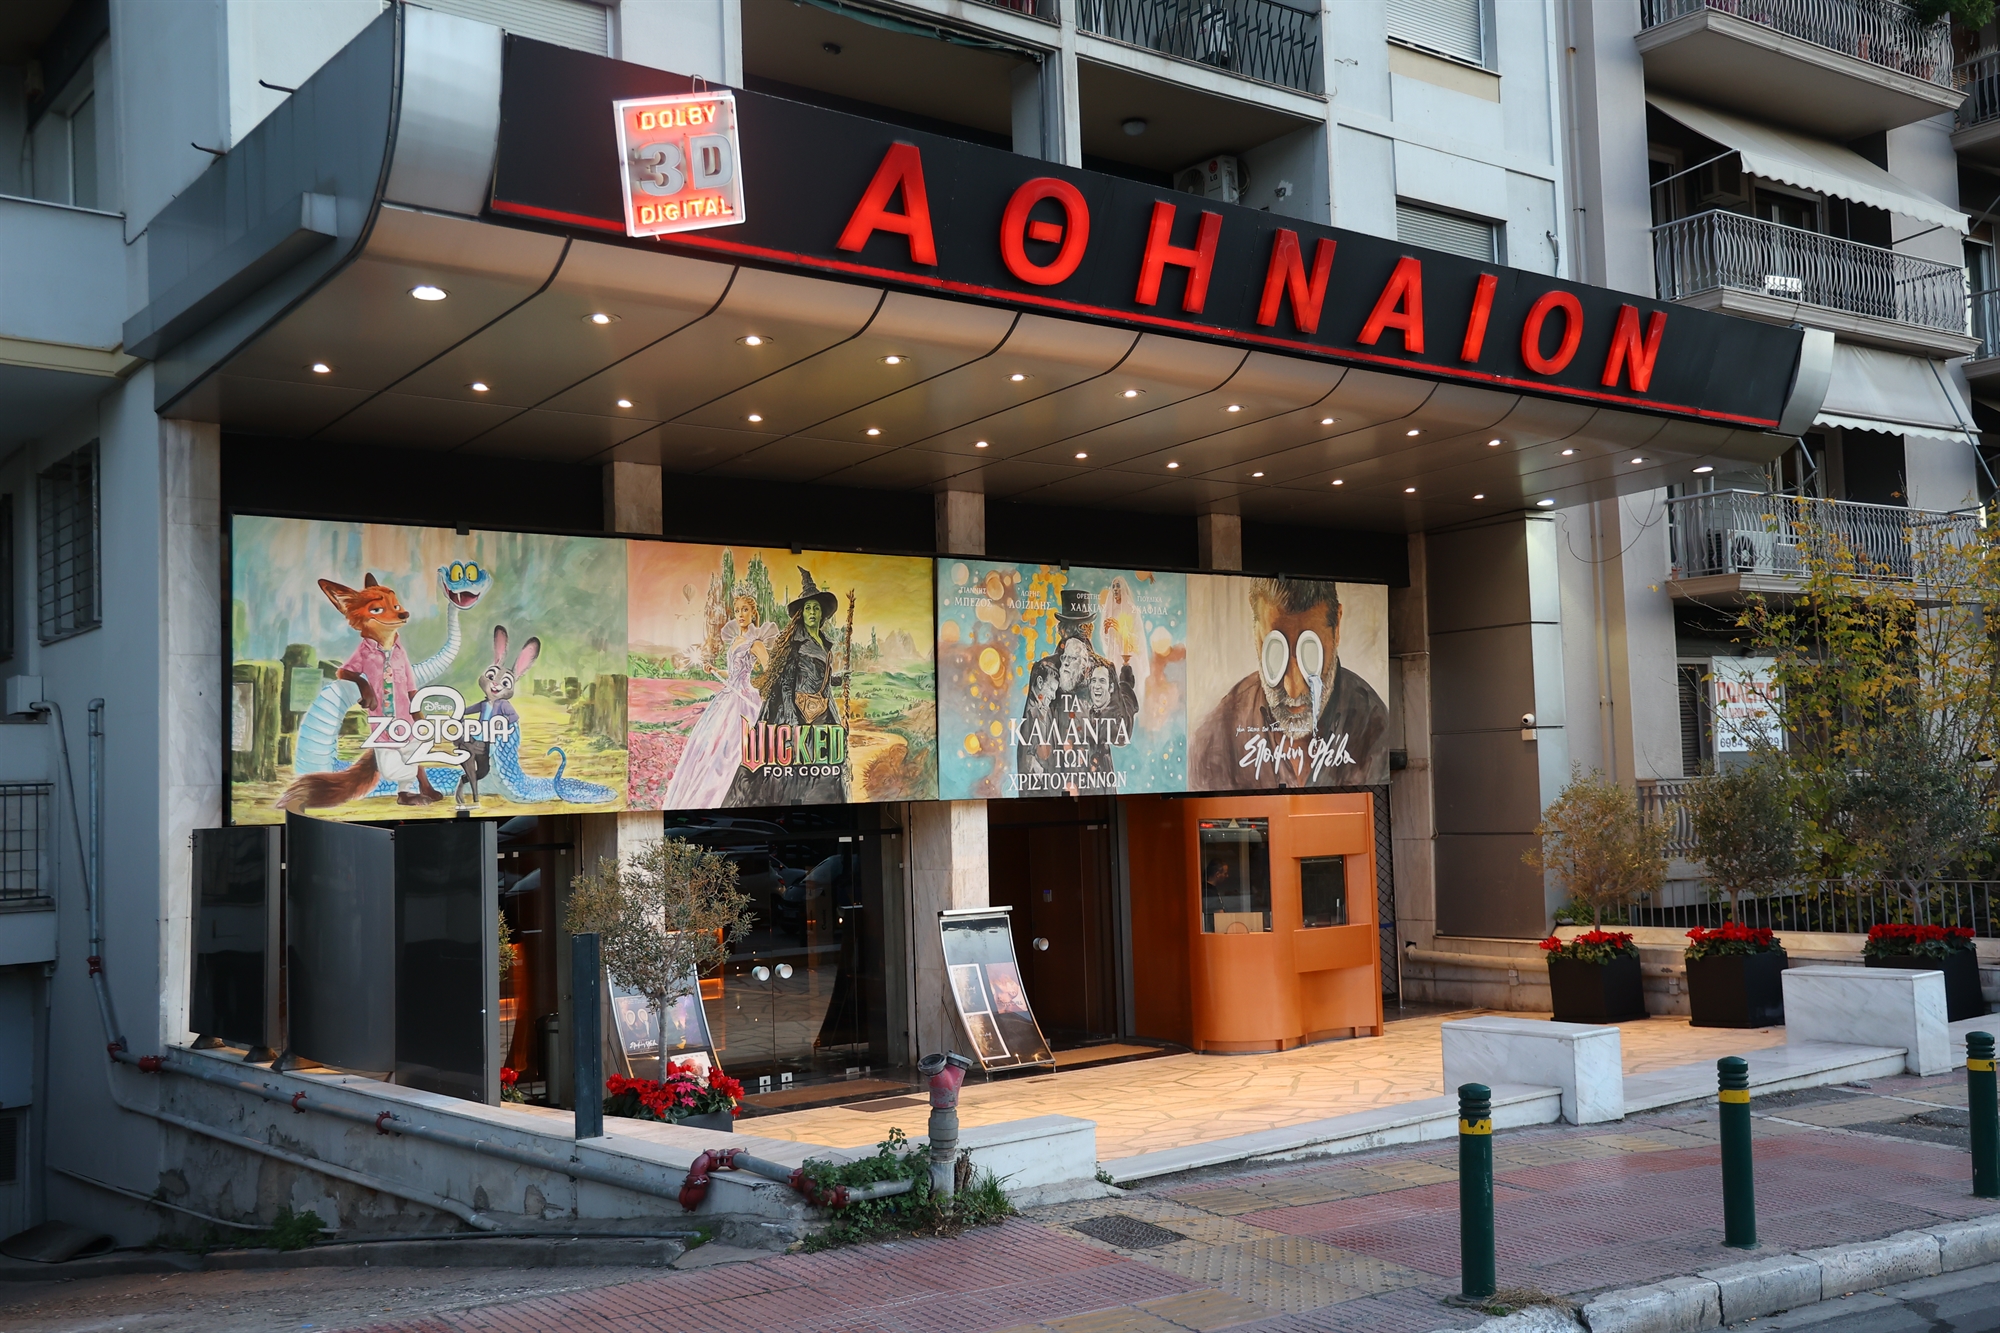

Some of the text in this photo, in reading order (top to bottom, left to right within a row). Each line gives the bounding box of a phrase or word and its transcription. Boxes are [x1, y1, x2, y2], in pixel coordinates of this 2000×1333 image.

[639, 104, 716, 130] DOLBY
[636, 133, 733, 196] 3D
[639, 197, 732, 225] DIGITAL
[836, 141, 1667, 393] ΑΘΗΝΑΙΟΝ
[955, 597, 993, 608] ΜΠΕΖΟΣ
[1061, 694, 1082, 713] ΤΑ
[404, 684, 472, 766] 2
[1009, 717, 1131, 746] ΚΑΛΑΝΤΑ
[740, 714, 845, 773] WICKED
[763, 765, 841, 777] FOR GOOD
[1053, 749, 1089, 768] ΤΩΝ
[1008, 770, 1127, 791] ΧΡΙΣΤΟΥΓΕΝΝΩΝ
